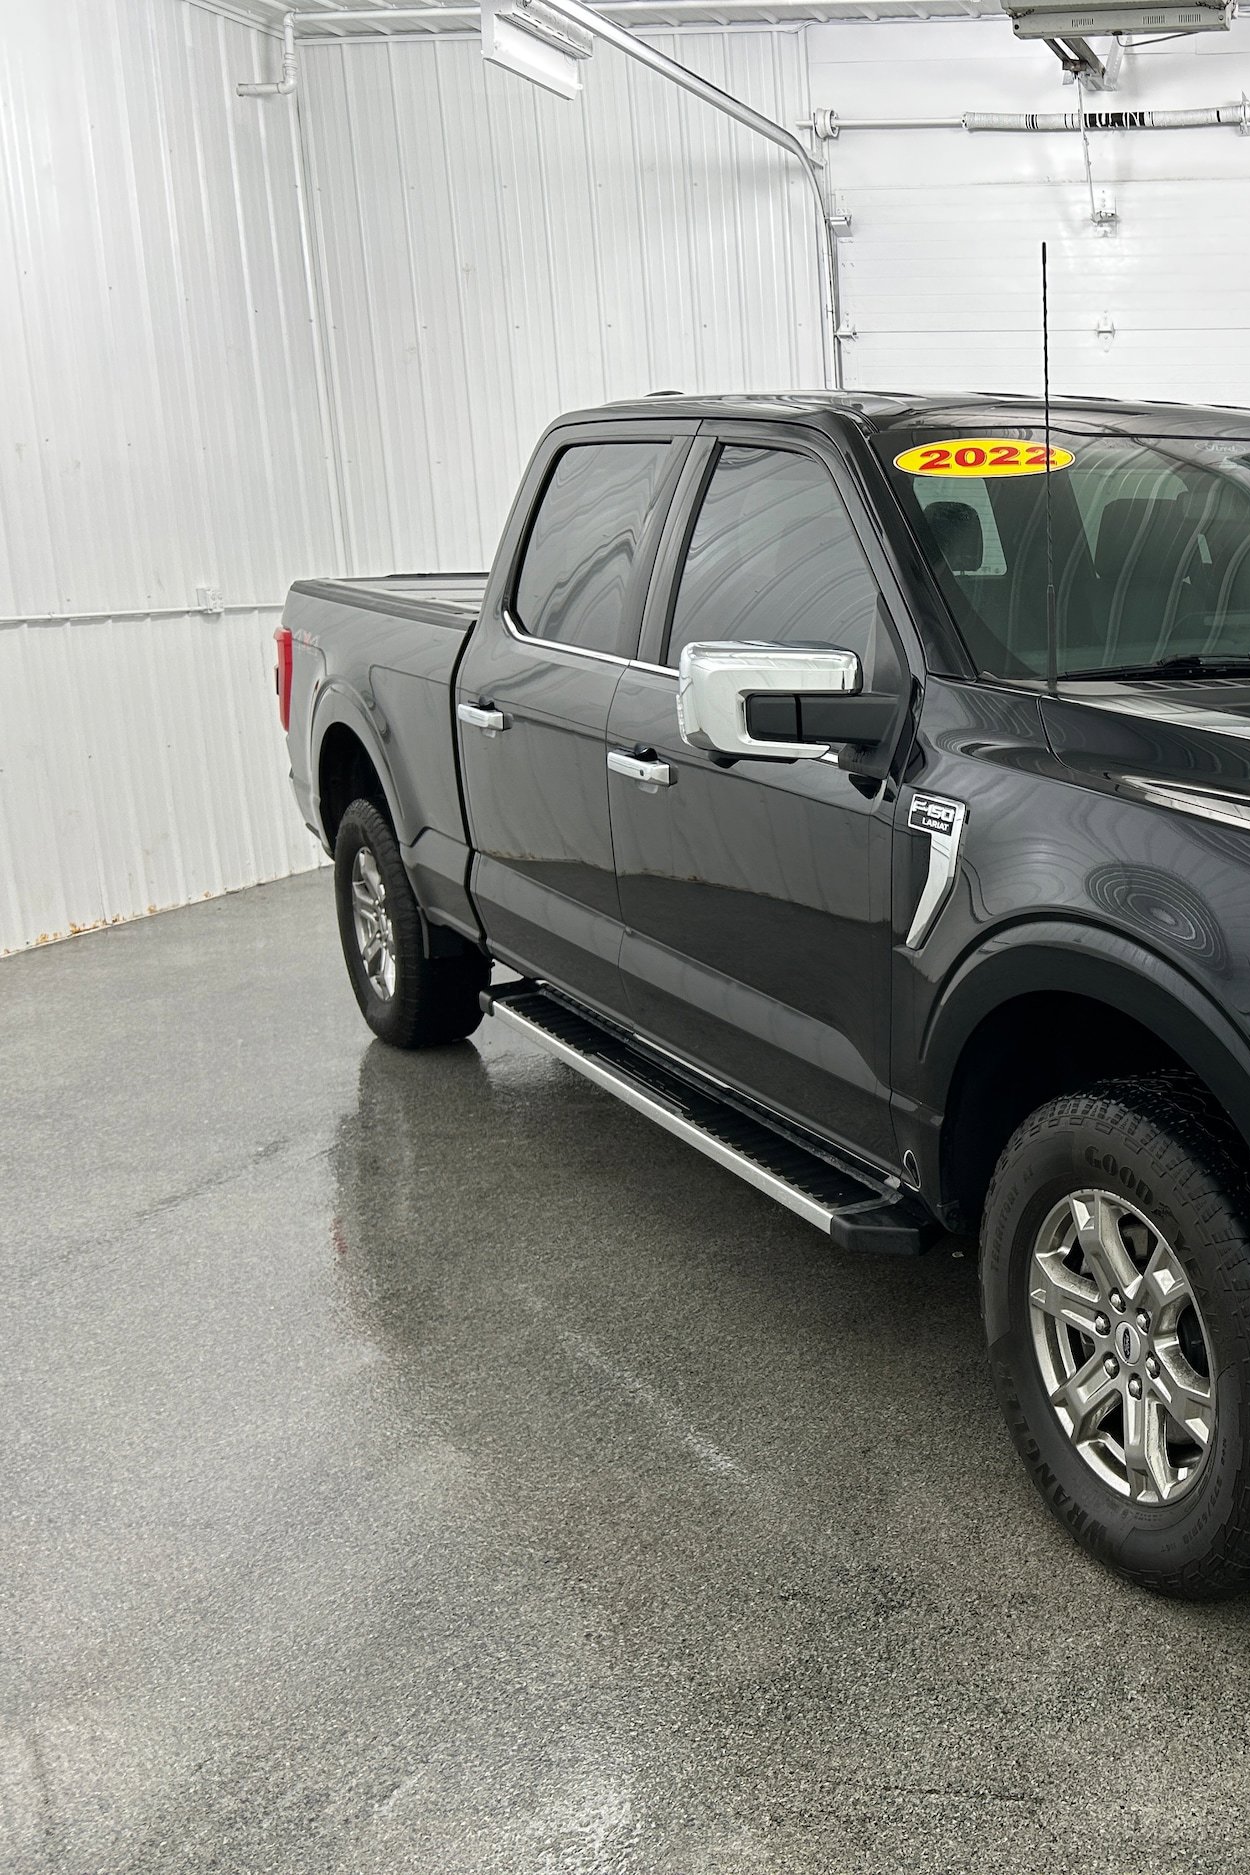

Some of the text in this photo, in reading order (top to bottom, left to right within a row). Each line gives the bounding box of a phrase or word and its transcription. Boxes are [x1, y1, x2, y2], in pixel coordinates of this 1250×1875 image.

[918, 446, 1057, 471] 2022
[911, 800, 956, 823] F-150
[921, 816, 950, 831] LARIAT
